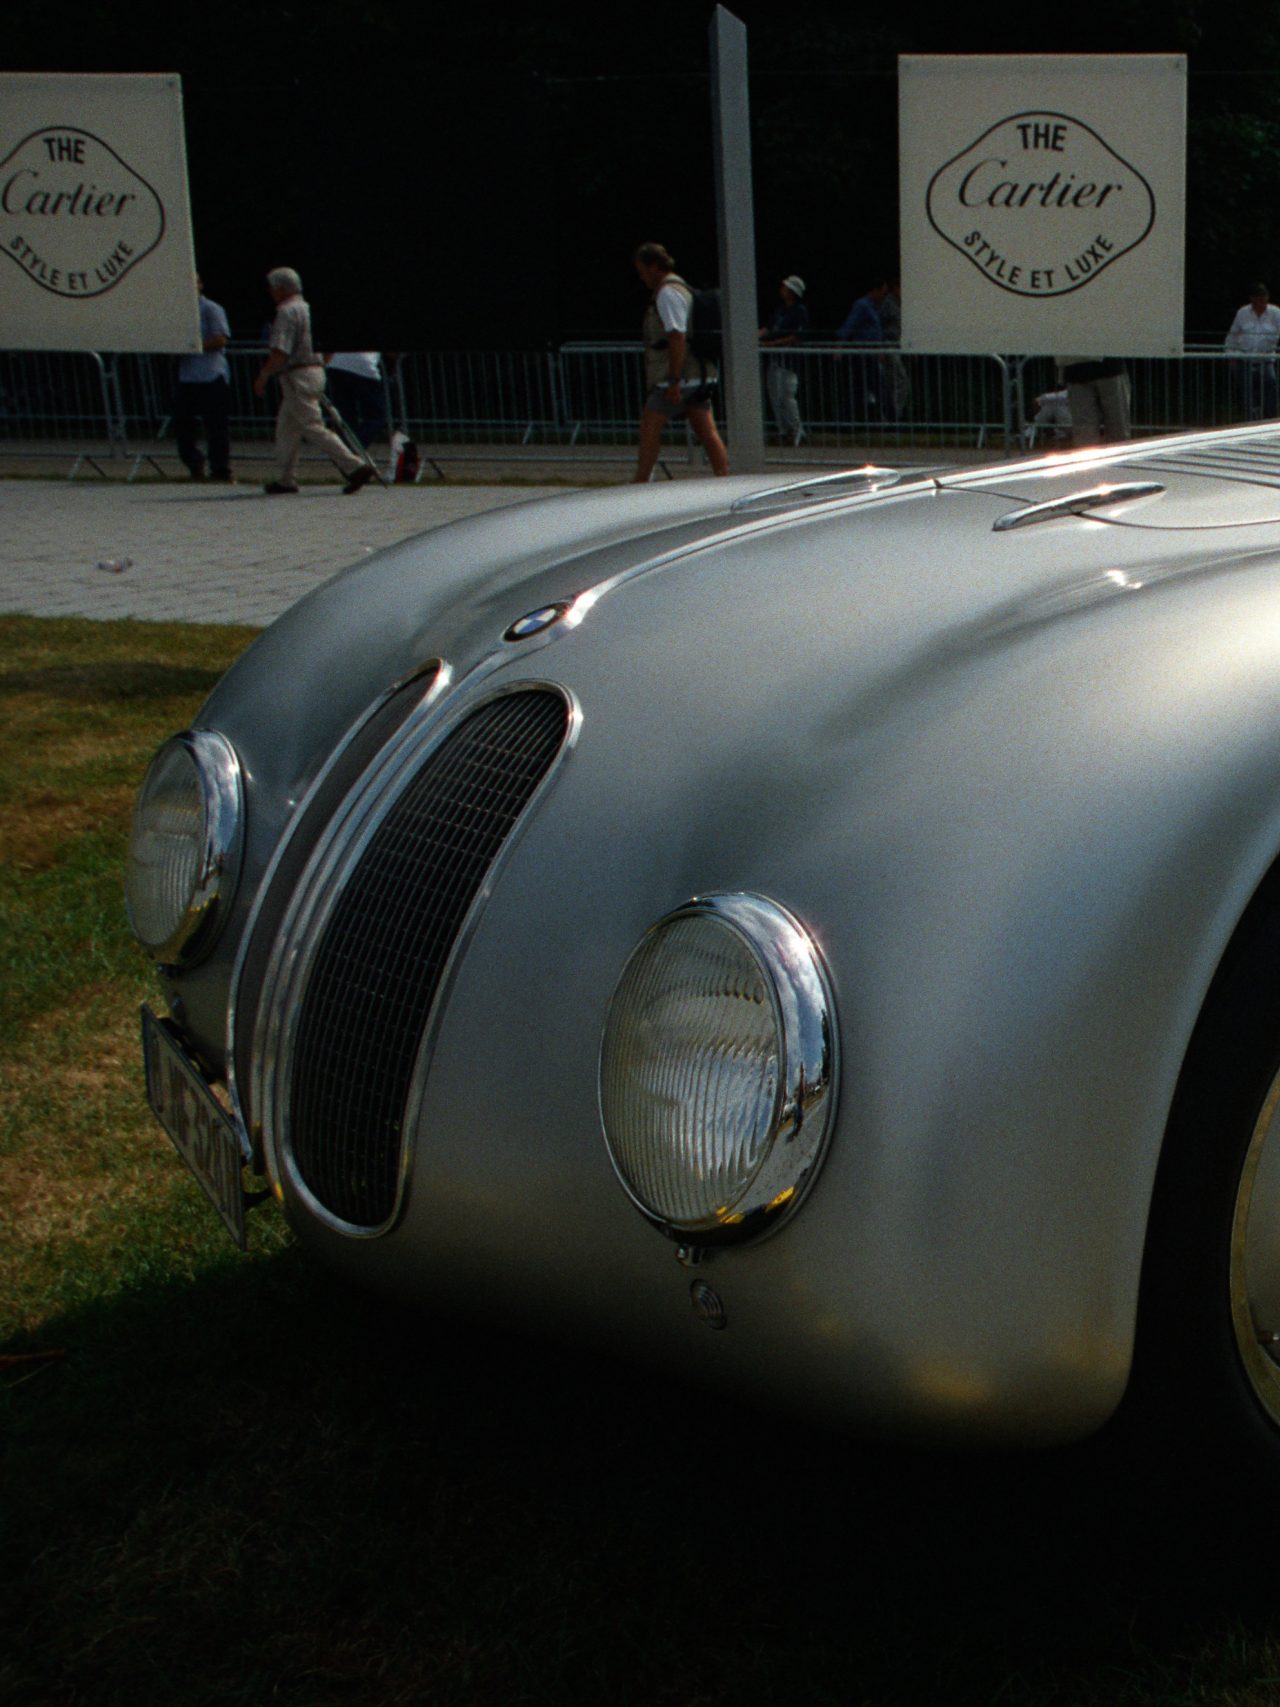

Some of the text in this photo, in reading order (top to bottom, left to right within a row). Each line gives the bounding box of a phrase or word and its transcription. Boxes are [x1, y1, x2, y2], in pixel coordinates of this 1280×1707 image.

[43, 138, 85, 164] THE
[1016, 123, 1067, 152] THE
[2, 169, 135, 216] Cartier
[958, 158, 1122, 208] Cartier
[10, 236, 133, 290] STYLE ET LUXE
[964, 230, 1114, 289] STYLE ET LUXE
